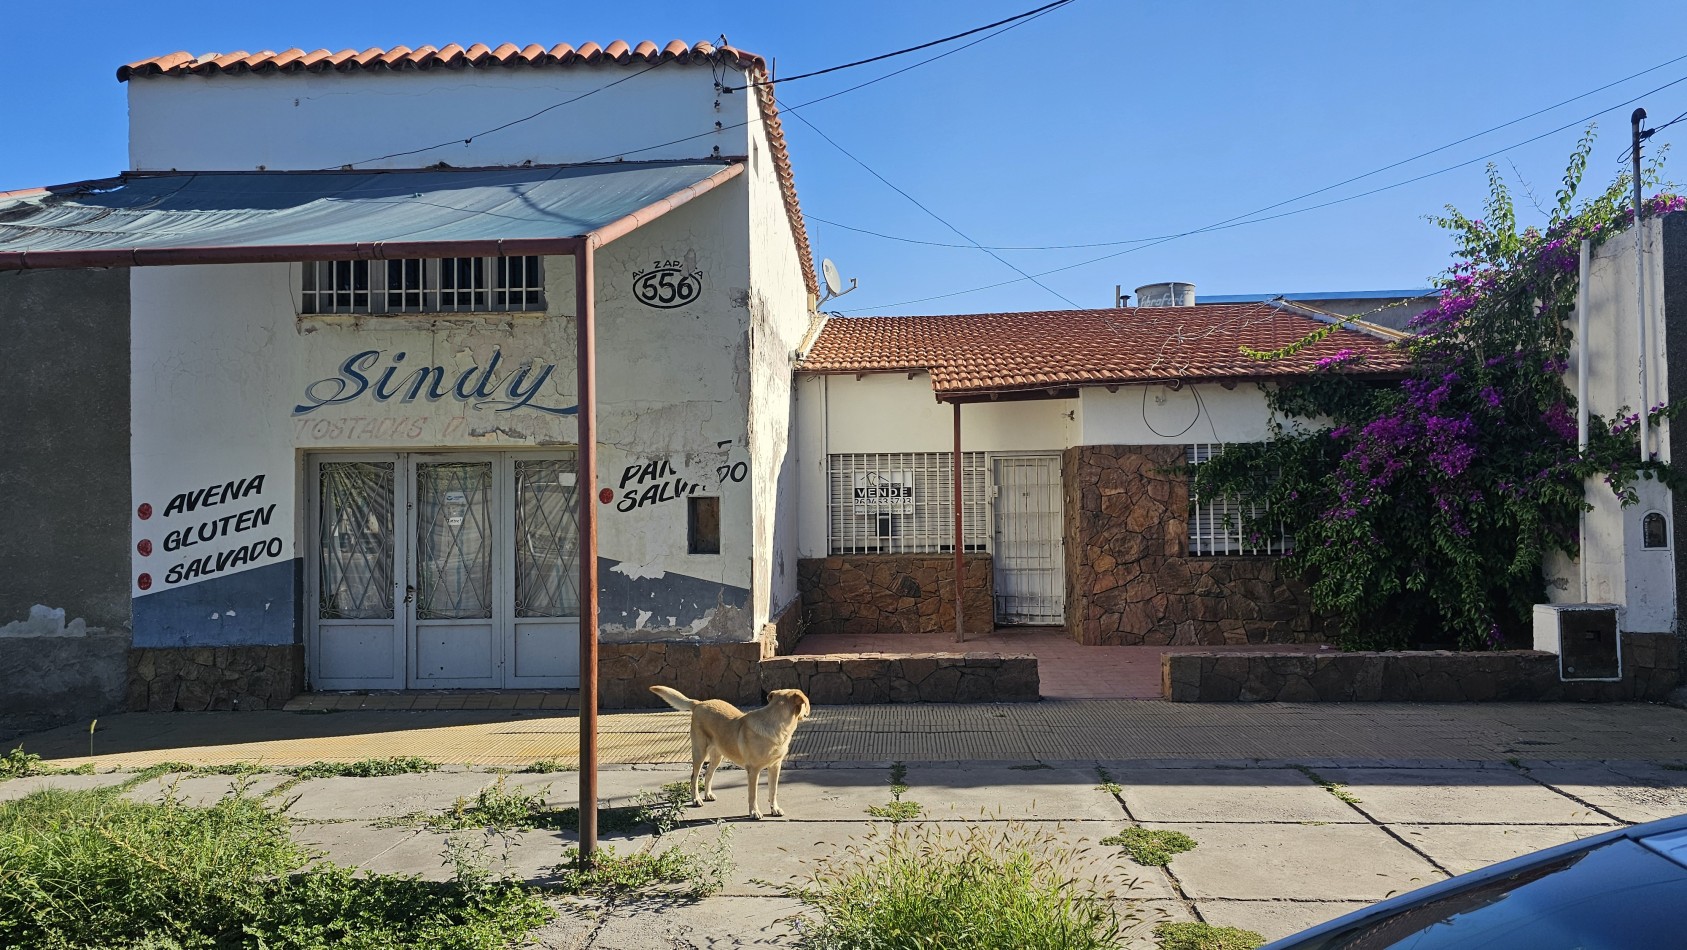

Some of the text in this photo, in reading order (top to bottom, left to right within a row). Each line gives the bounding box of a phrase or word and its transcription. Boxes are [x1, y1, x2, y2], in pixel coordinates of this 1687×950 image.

[641, 272, 694, 304] 556
[290, 348, 579, 416] Sindy
[163, 474, 266, 518] AVENA
[857, 488, 908, 497] VENDE
[163, 503, 277, 552] GLUTEN
[164, 536, 283, 584] SALVADO
